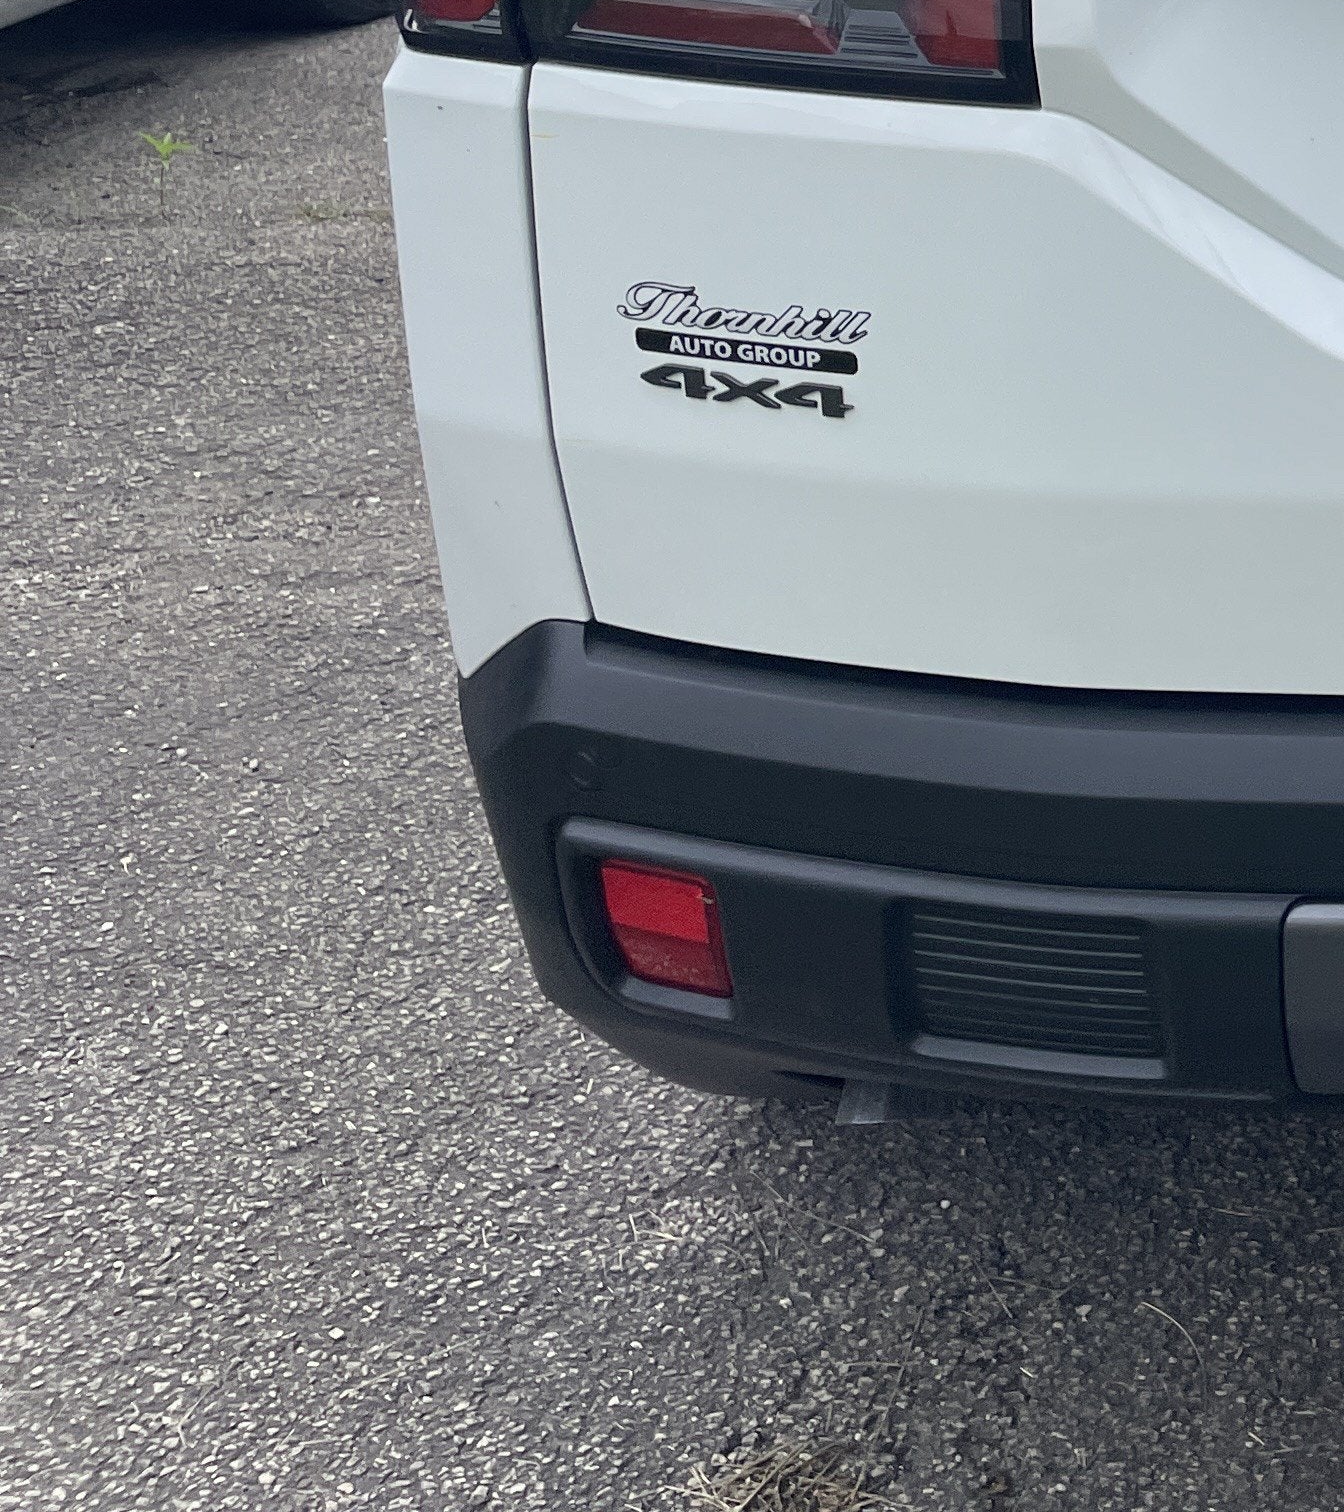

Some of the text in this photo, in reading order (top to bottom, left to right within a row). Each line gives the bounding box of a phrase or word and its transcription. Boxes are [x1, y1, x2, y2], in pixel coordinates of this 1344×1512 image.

[616, 281, 871, 345] Thornhill
[669, 335, 821, 368] AUTO GROUP
